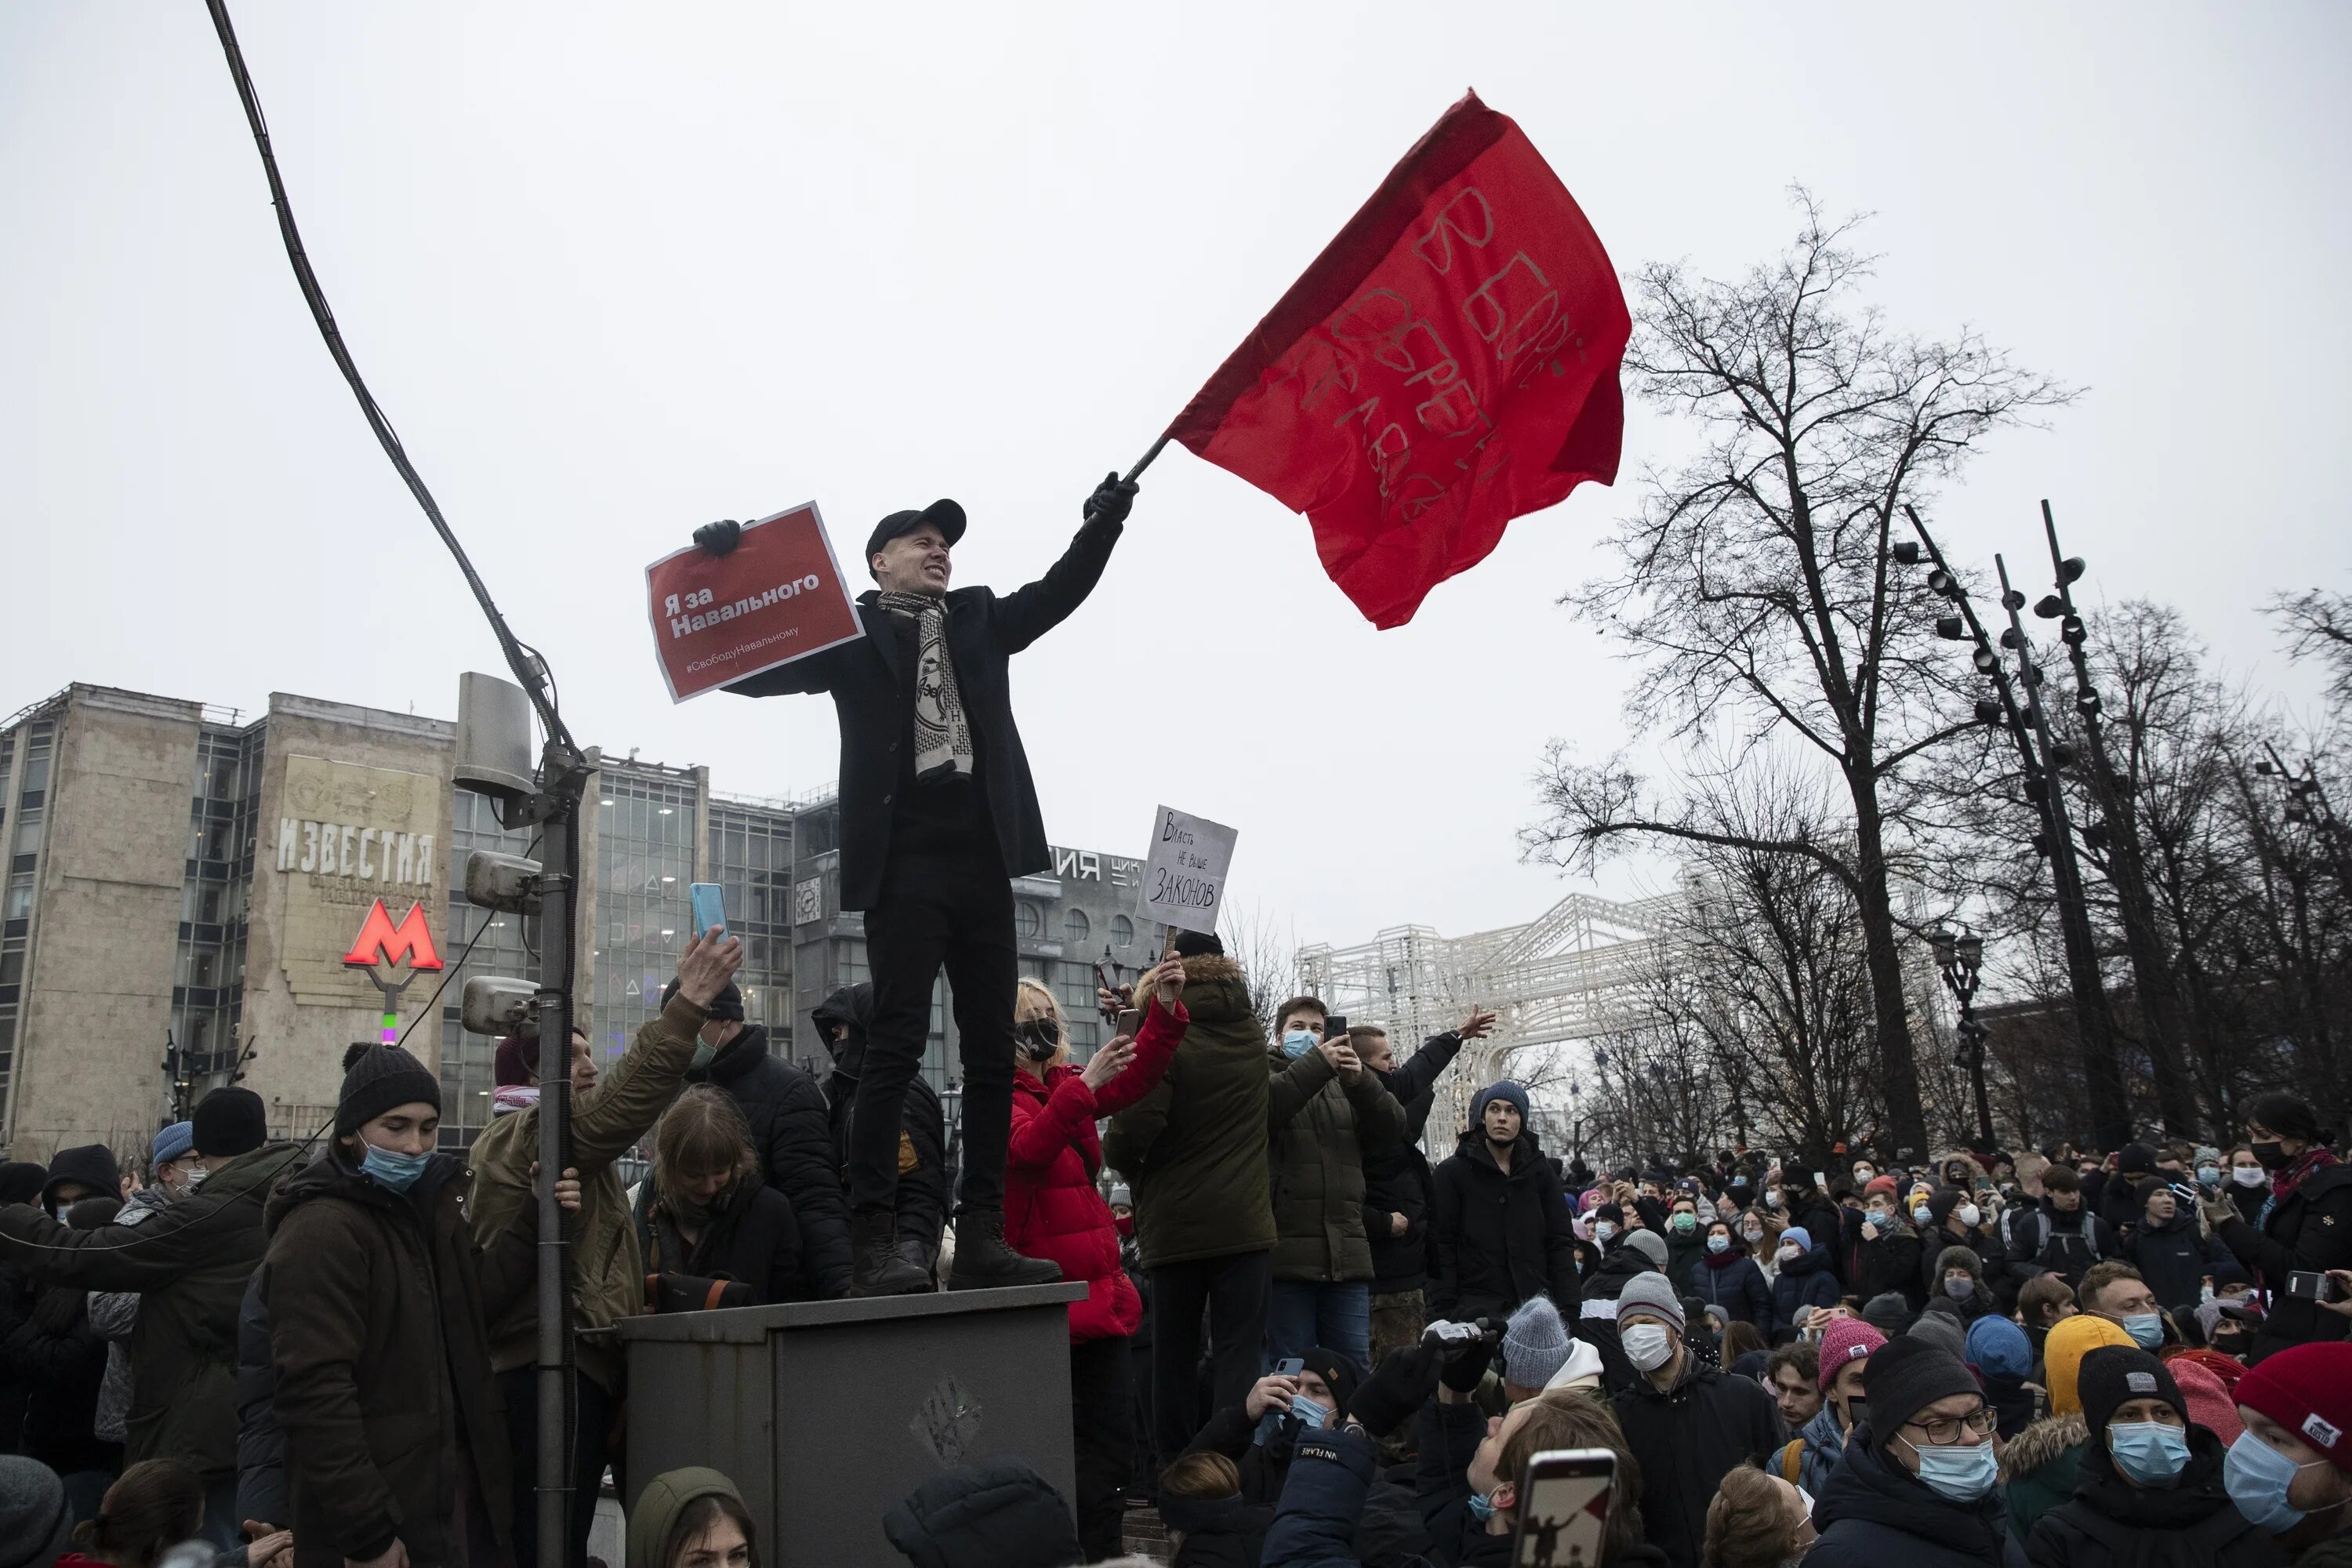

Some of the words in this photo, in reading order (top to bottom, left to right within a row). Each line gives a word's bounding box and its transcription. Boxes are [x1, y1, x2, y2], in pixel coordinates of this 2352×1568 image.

[665, 593, 681, 617] Я
[684, 588, 714, 609] за
[671, 574, 820, 639] Навального
[686, 627, 799, 673] #СвободуНавальному
[277, 818, 434, 885] ИЗВЕСТИЯ
[1048, 846, 1100, 881] ИЯ
[1111, 857, 1140, 873] ЦИК
[1149, 868, 1214, 907] ЗАКОНОВ
[343, 897, 444, 970] М
[1301, 1447, 1324, 1457] FLARE
[2308, 1425, 2330, 1445] KUSTO
